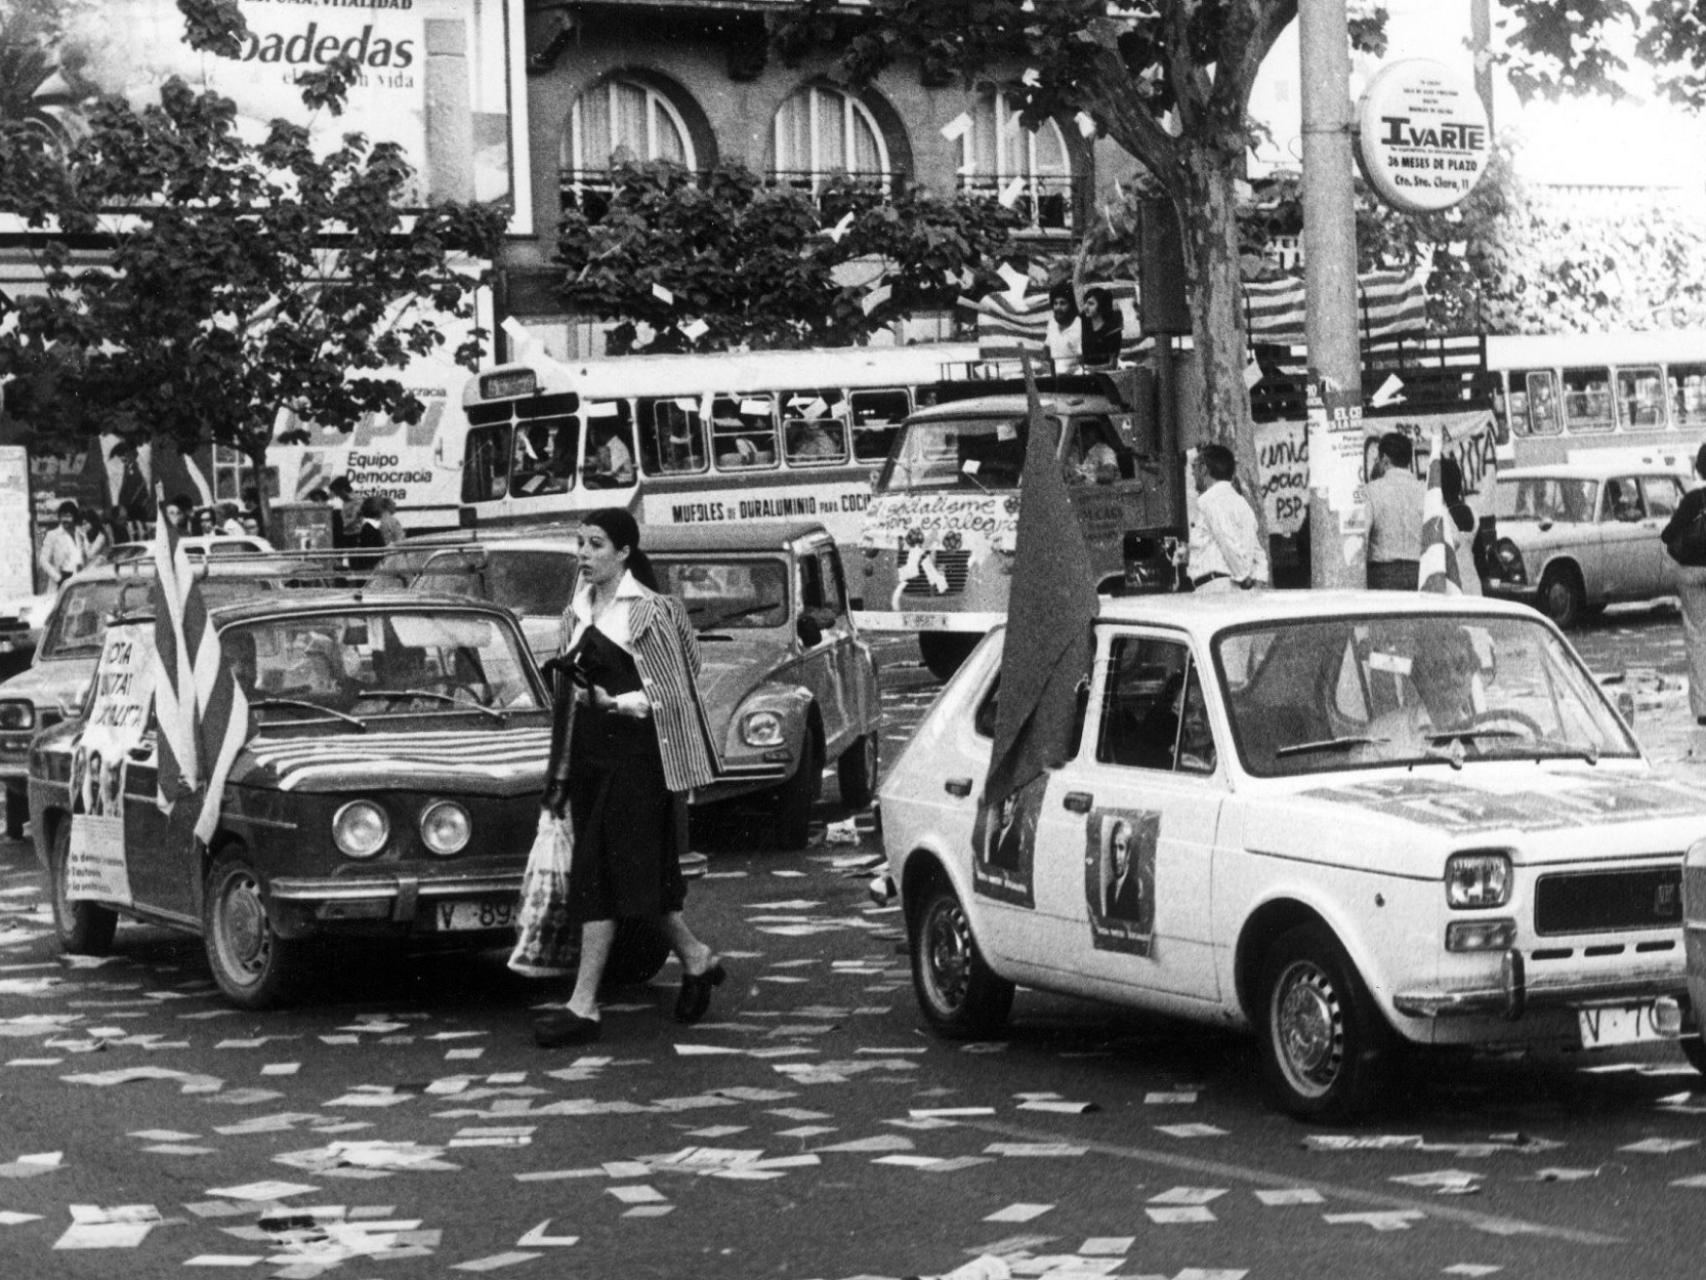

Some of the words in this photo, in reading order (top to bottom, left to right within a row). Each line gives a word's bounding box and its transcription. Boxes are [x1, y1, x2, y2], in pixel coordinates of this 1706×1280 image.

[1381, 116, 1485, 150] IVARTE
[1388, 155, 1399, 168] 36
[1401, 156, 1430, 169] MESES
[1433, 158, 1445, 170] DE
[1448, 159, 1478, 171] PLAZO
[347, 452, 399, 469] Equipo
[346, 469, 433, 483] Democracia
[353, 485, 407, 500] istiana
[739, 496, 816, 519] DURALUMINIO
